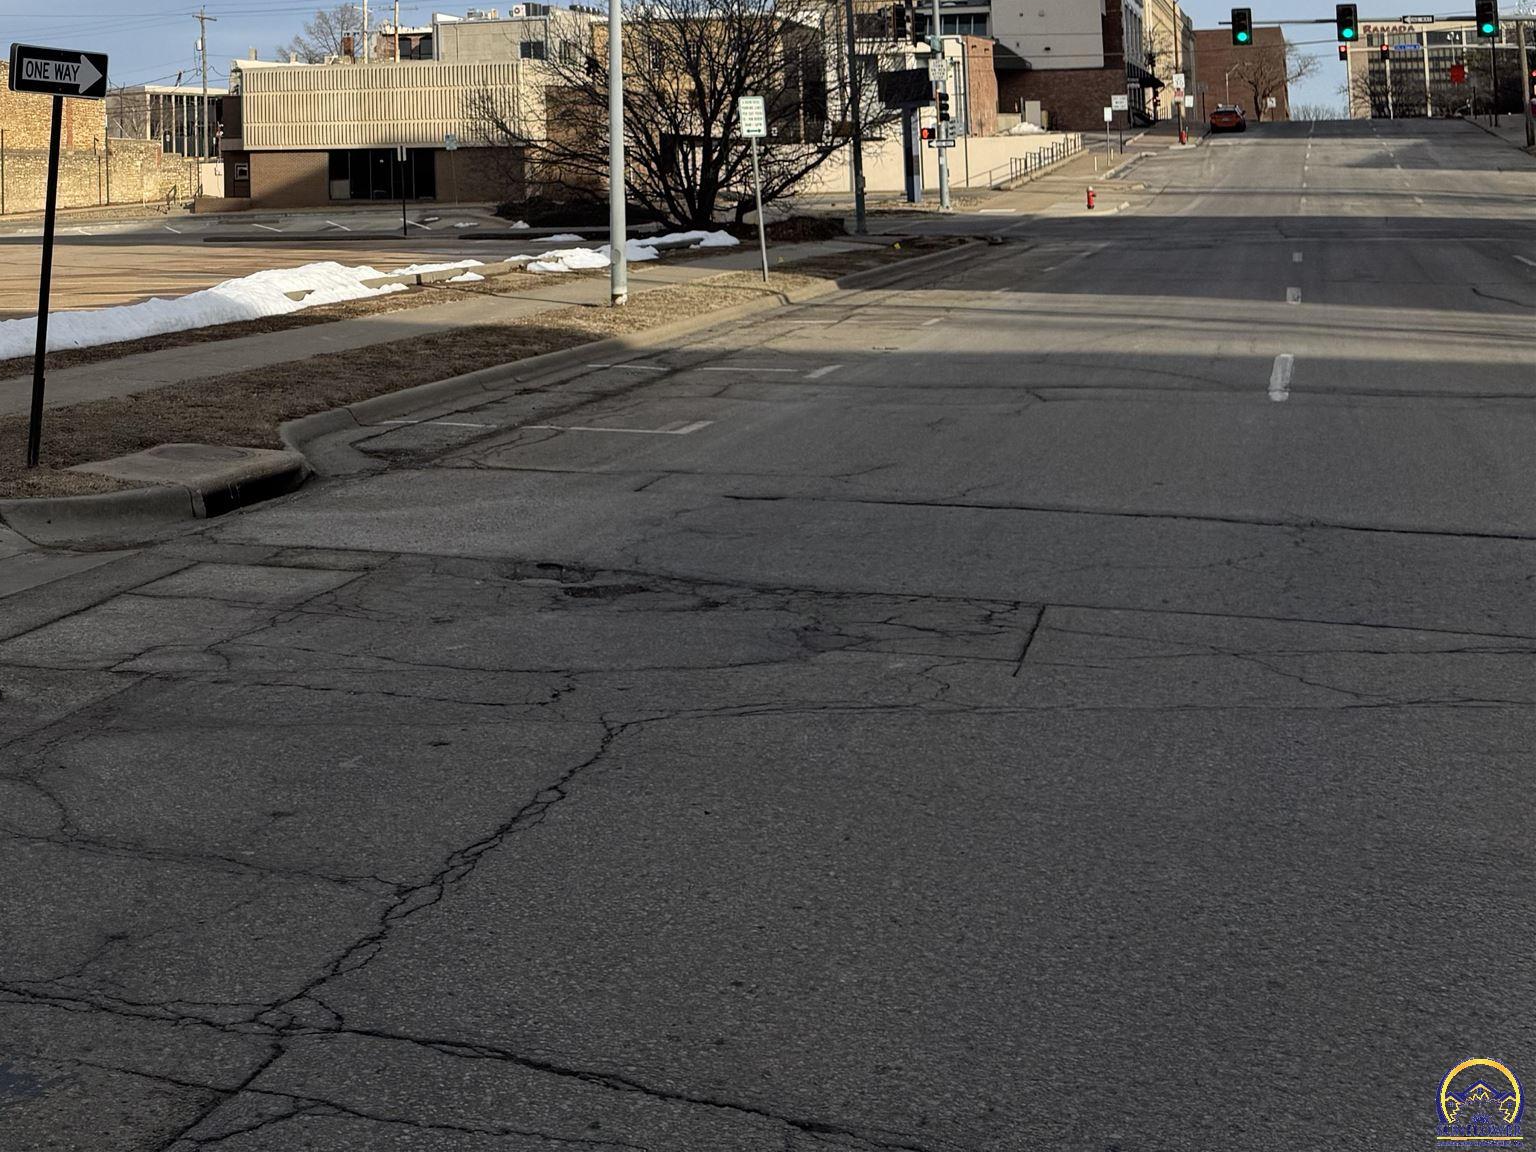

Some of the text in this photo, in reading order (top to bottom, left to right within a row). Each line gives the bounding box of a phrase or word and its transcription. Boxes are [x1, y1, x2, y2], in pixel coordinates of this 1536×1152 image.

[1363, 25, 1415, 34] RAMADA
[25, 60, 81, 82] ONE WAY
